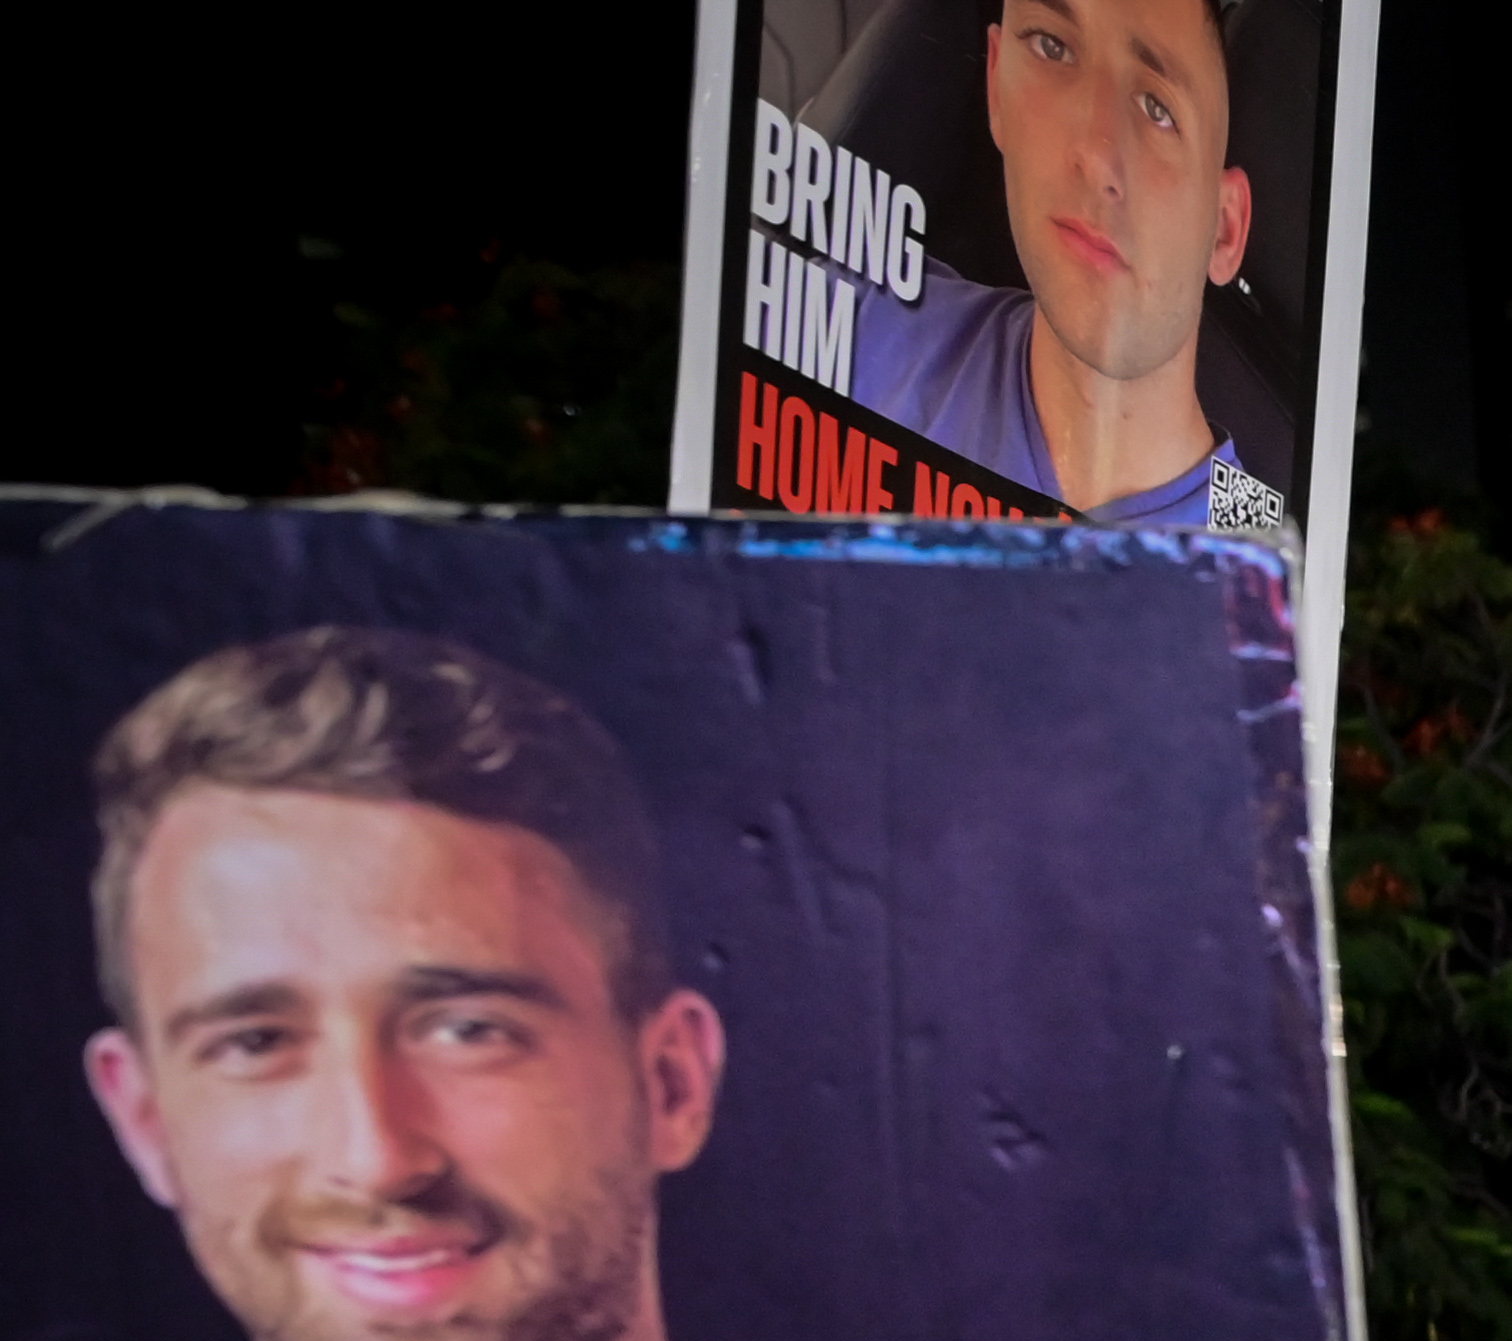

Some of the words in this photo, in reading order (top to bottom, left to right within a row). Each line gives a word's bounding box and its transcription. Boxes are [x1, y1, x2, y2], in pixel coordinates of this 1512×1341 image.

[751, 98, 926, 302] BRING
[743, 228, 856, 397] HIM
[735, 372, 898, 517] HOME
